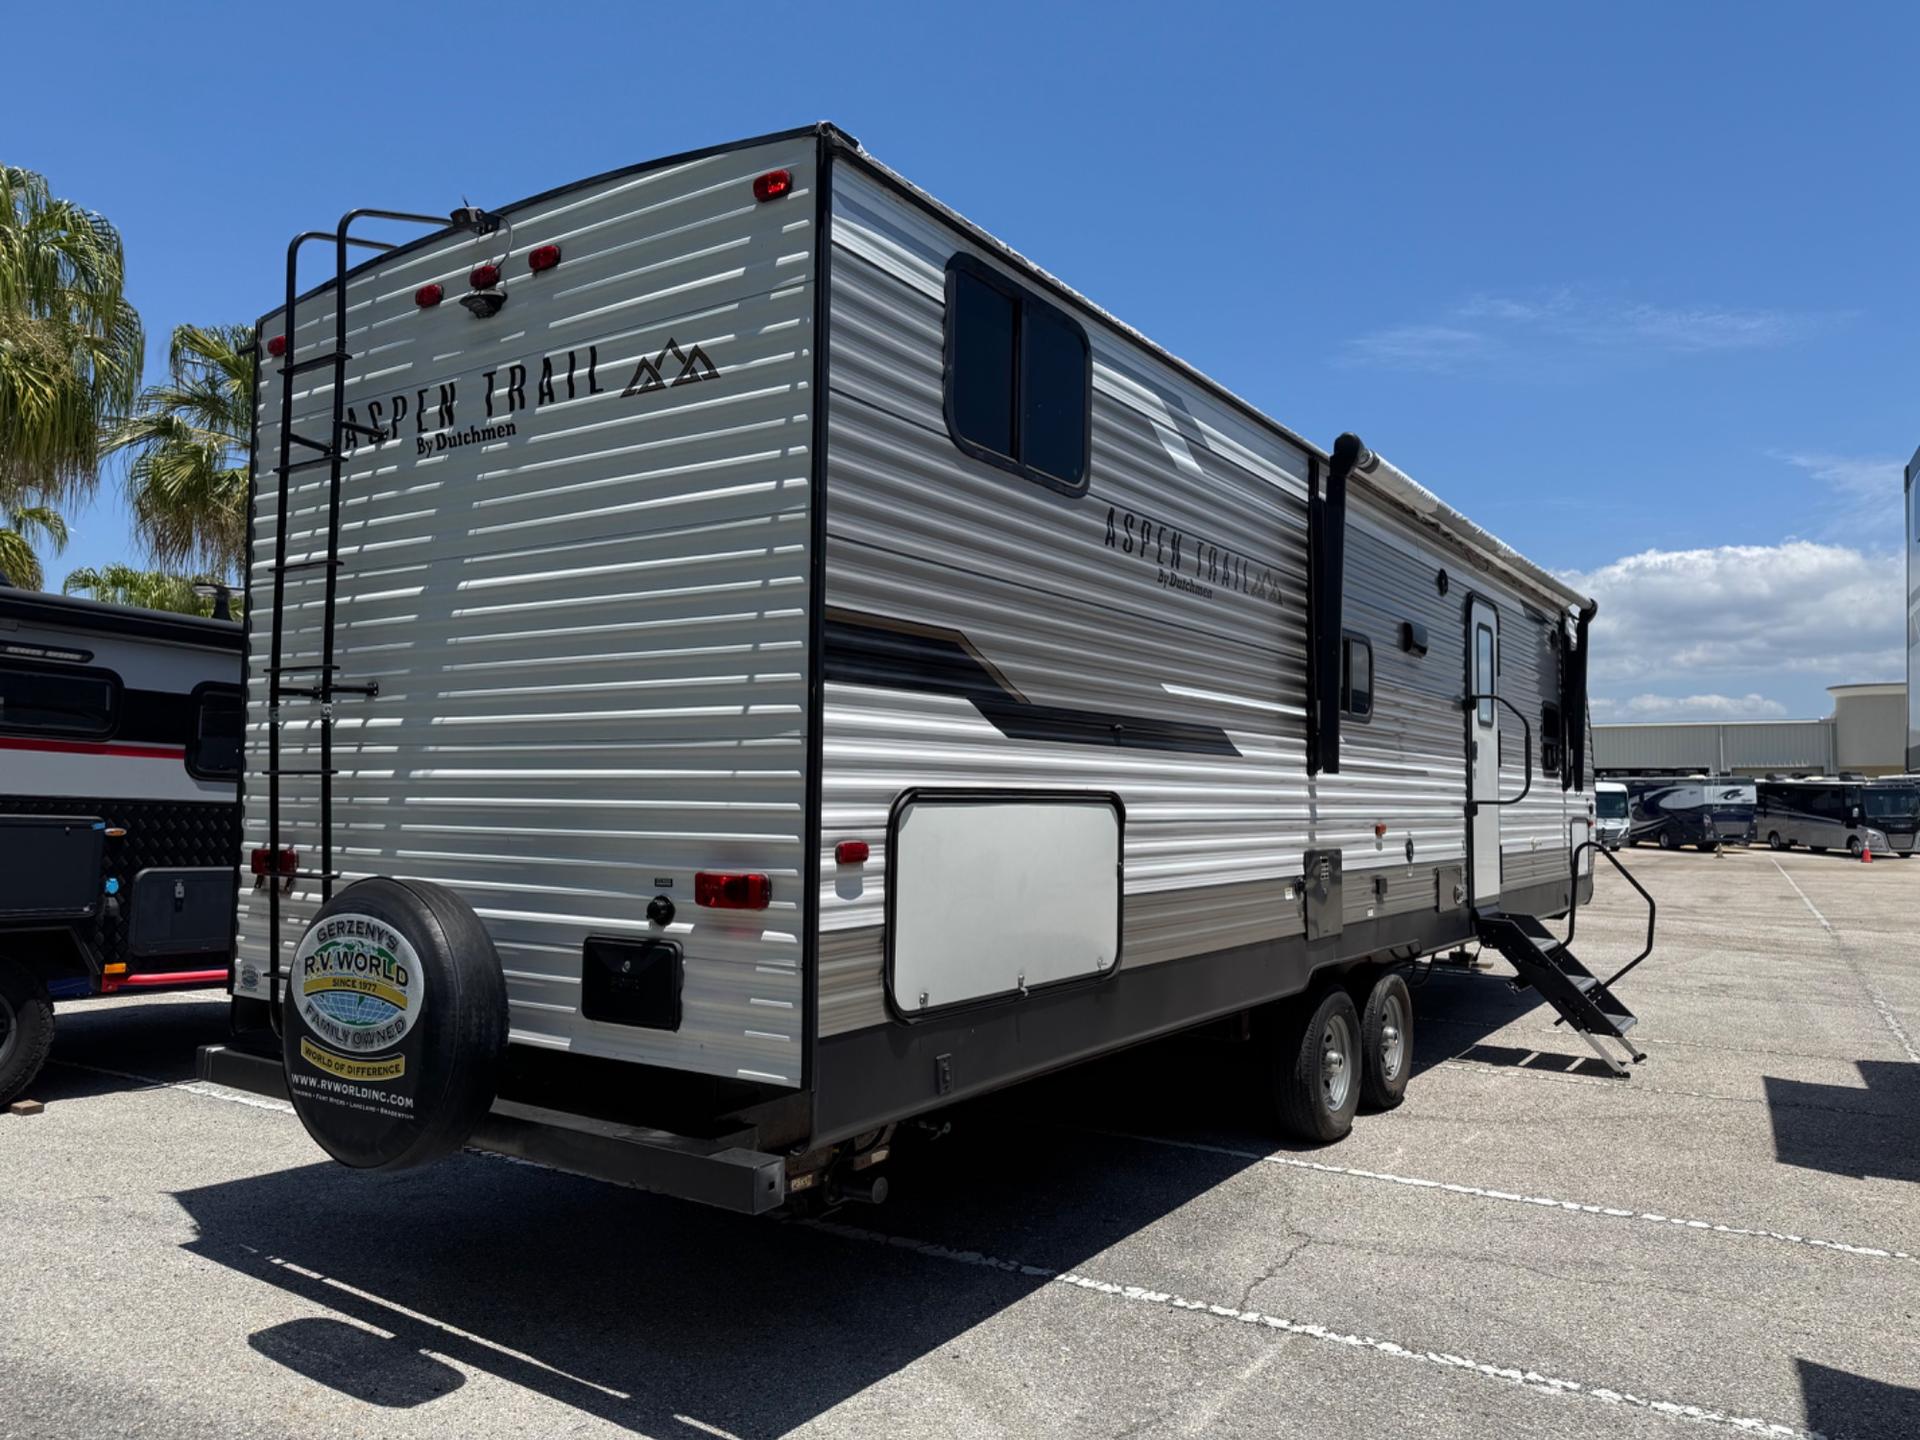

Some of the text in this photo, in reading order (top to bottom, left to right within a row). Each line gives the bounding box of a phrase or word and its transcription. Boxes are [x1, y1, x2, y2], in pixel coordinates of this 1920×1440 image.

[345, 345, 603, 450] ASPEN TRAIL
[416, 422, 516, 458] By Dutchmen
[1105, 507, 1249, 594] ASPEN TRAIL
[1157, 568, 1213, 600] By Dutchmen
[317, 919, 399, 951] GERZENY'S
[304, 951, 409, 988] R.V. WORLD
[332, 979, 377, 993] SINCE 1977
[305, 1003, 406, 1047] FAMILY OWNED
[304, 1046, 401, 1076] WORLD OF DIFFERENCE
[291, 1073, 414, 1108] WWW.RVWORLDINC.COM
